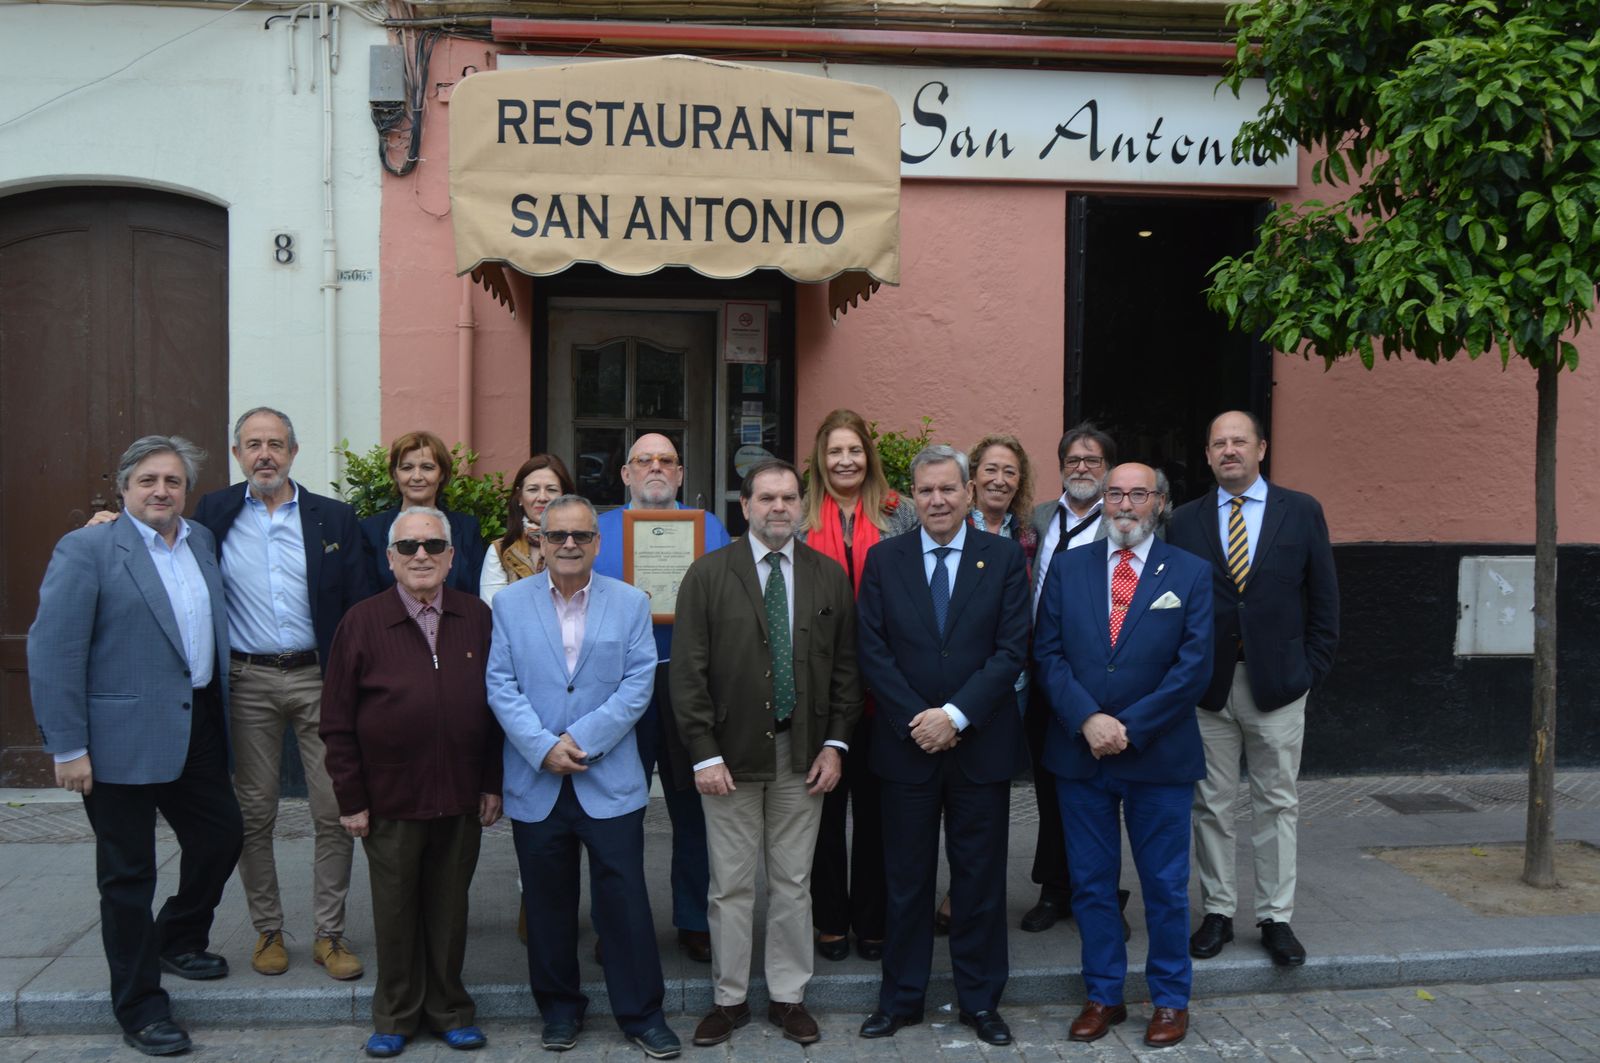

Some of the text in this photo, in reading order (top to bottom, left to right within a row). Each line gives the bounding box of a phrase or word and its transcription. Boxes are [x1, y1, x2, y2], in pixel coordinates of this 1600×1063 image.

[497, 99, 855, 155] RESTAURANTE
[900, 81, 1016, 165] San
[511, 193, 844, 245] SAN ANTONIO
[274, 233, 293, 265] 8
